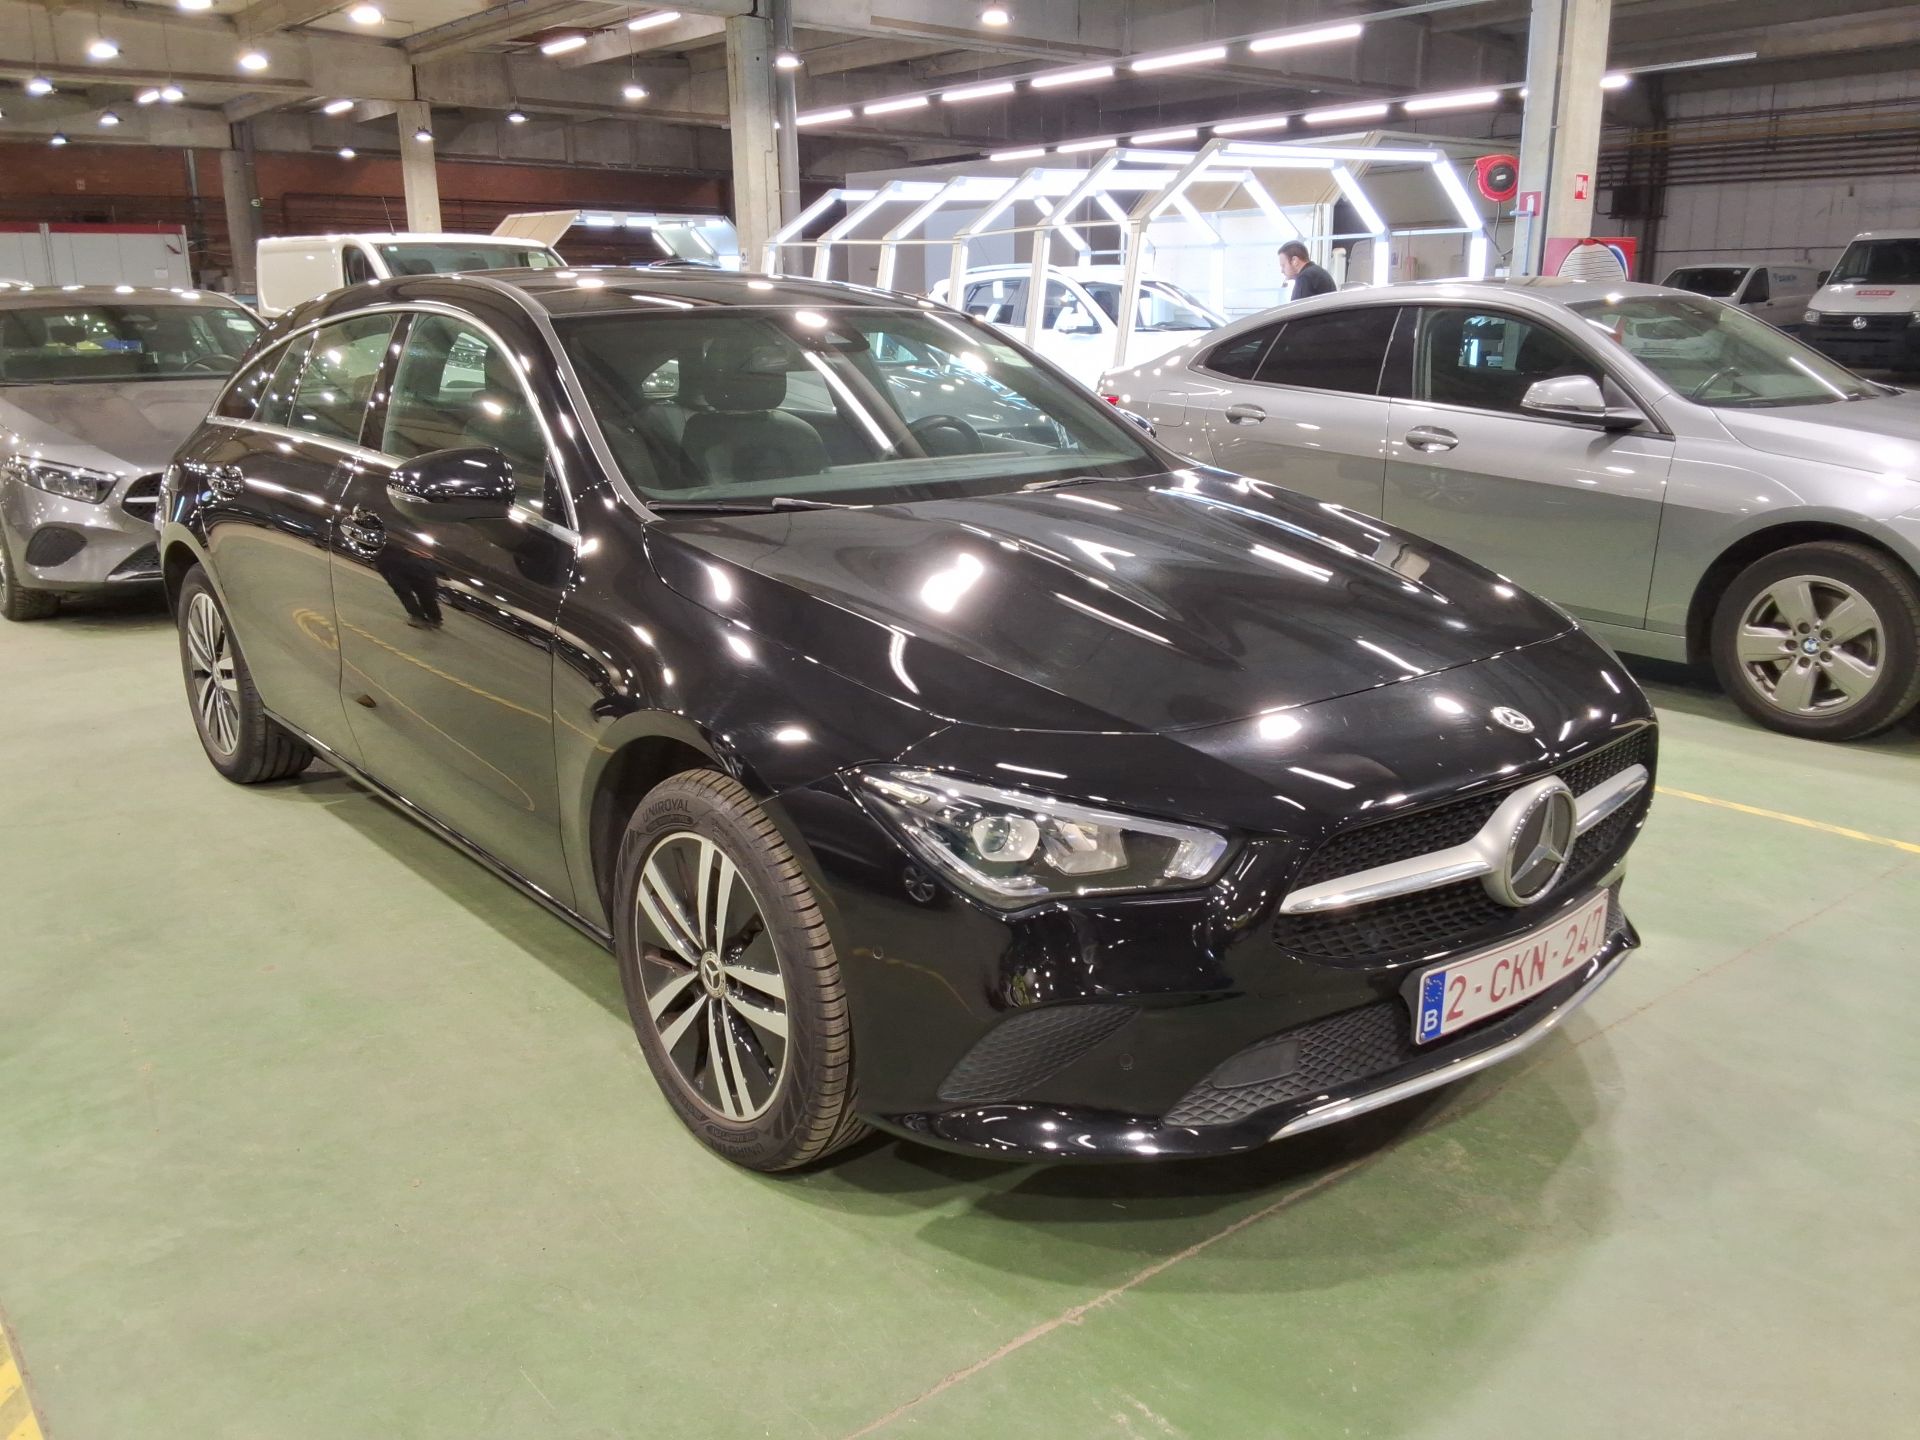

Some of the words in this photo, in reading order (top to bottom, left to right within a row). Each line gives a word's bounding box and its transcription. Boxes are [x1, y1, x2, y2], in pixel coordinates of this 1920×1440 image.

[642, 799, 692, 822] UNIROYAL
[1446, 906, 1604, 1022] 2-CKN-247
[1423, 1009, 1438, 1032] B
